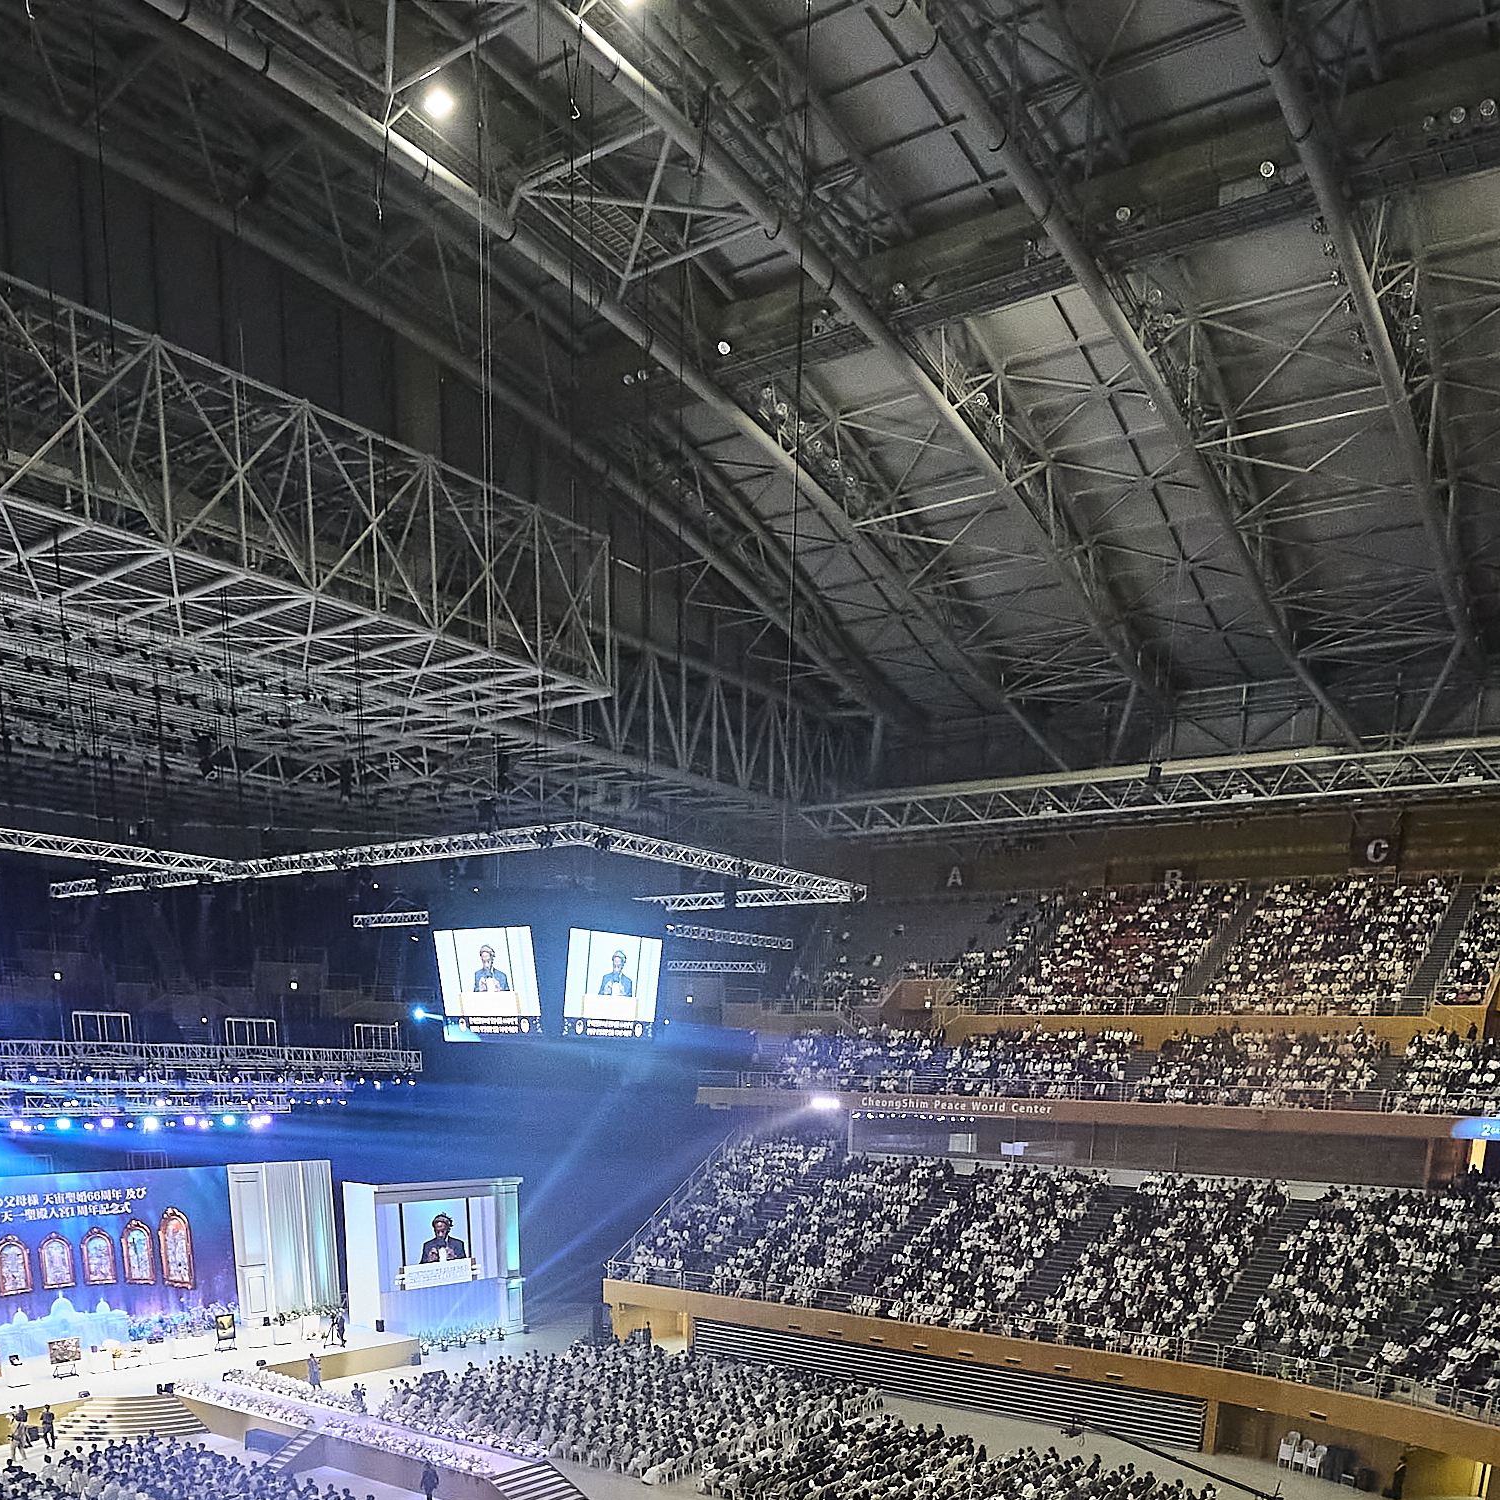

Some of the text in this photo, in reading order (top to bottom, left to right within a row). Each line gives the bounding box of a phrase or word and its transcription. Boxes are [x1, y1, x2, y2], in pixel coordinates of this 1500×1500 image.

[1366, 839, 1390, 864] C
[946, 866, 962, 886] A
[861, 1097, 1053, 1114] CheongShim Peace World Center
[1481, 1124, 1491, 1137] 2
